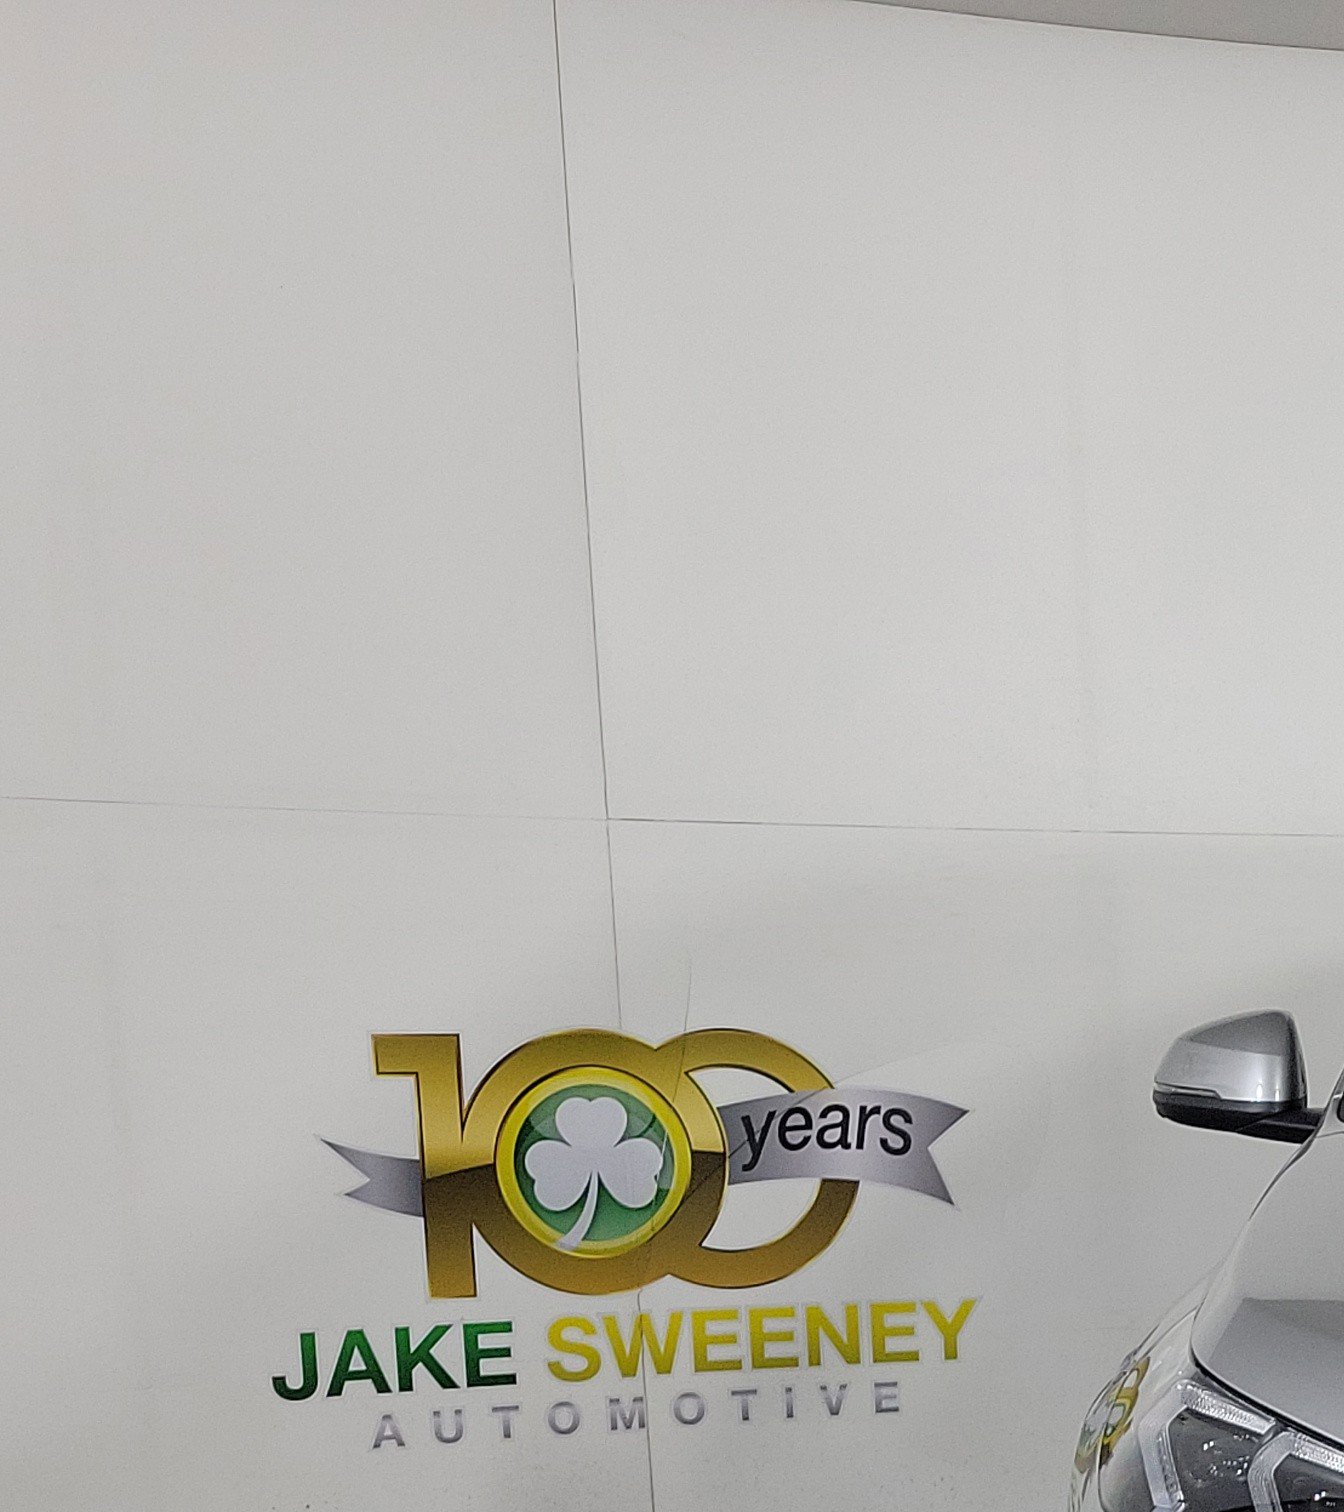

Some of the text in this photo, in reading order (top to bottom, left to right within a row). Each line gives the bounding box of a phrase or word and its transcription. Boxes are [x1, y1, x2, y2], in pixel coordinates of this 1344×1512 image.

[741, 1102, 913, 1173] years
[271, 1299, 979, 1401] JAKE SWEENEY
[372, 1381, 901, 1449] AUTOMOTIVE
